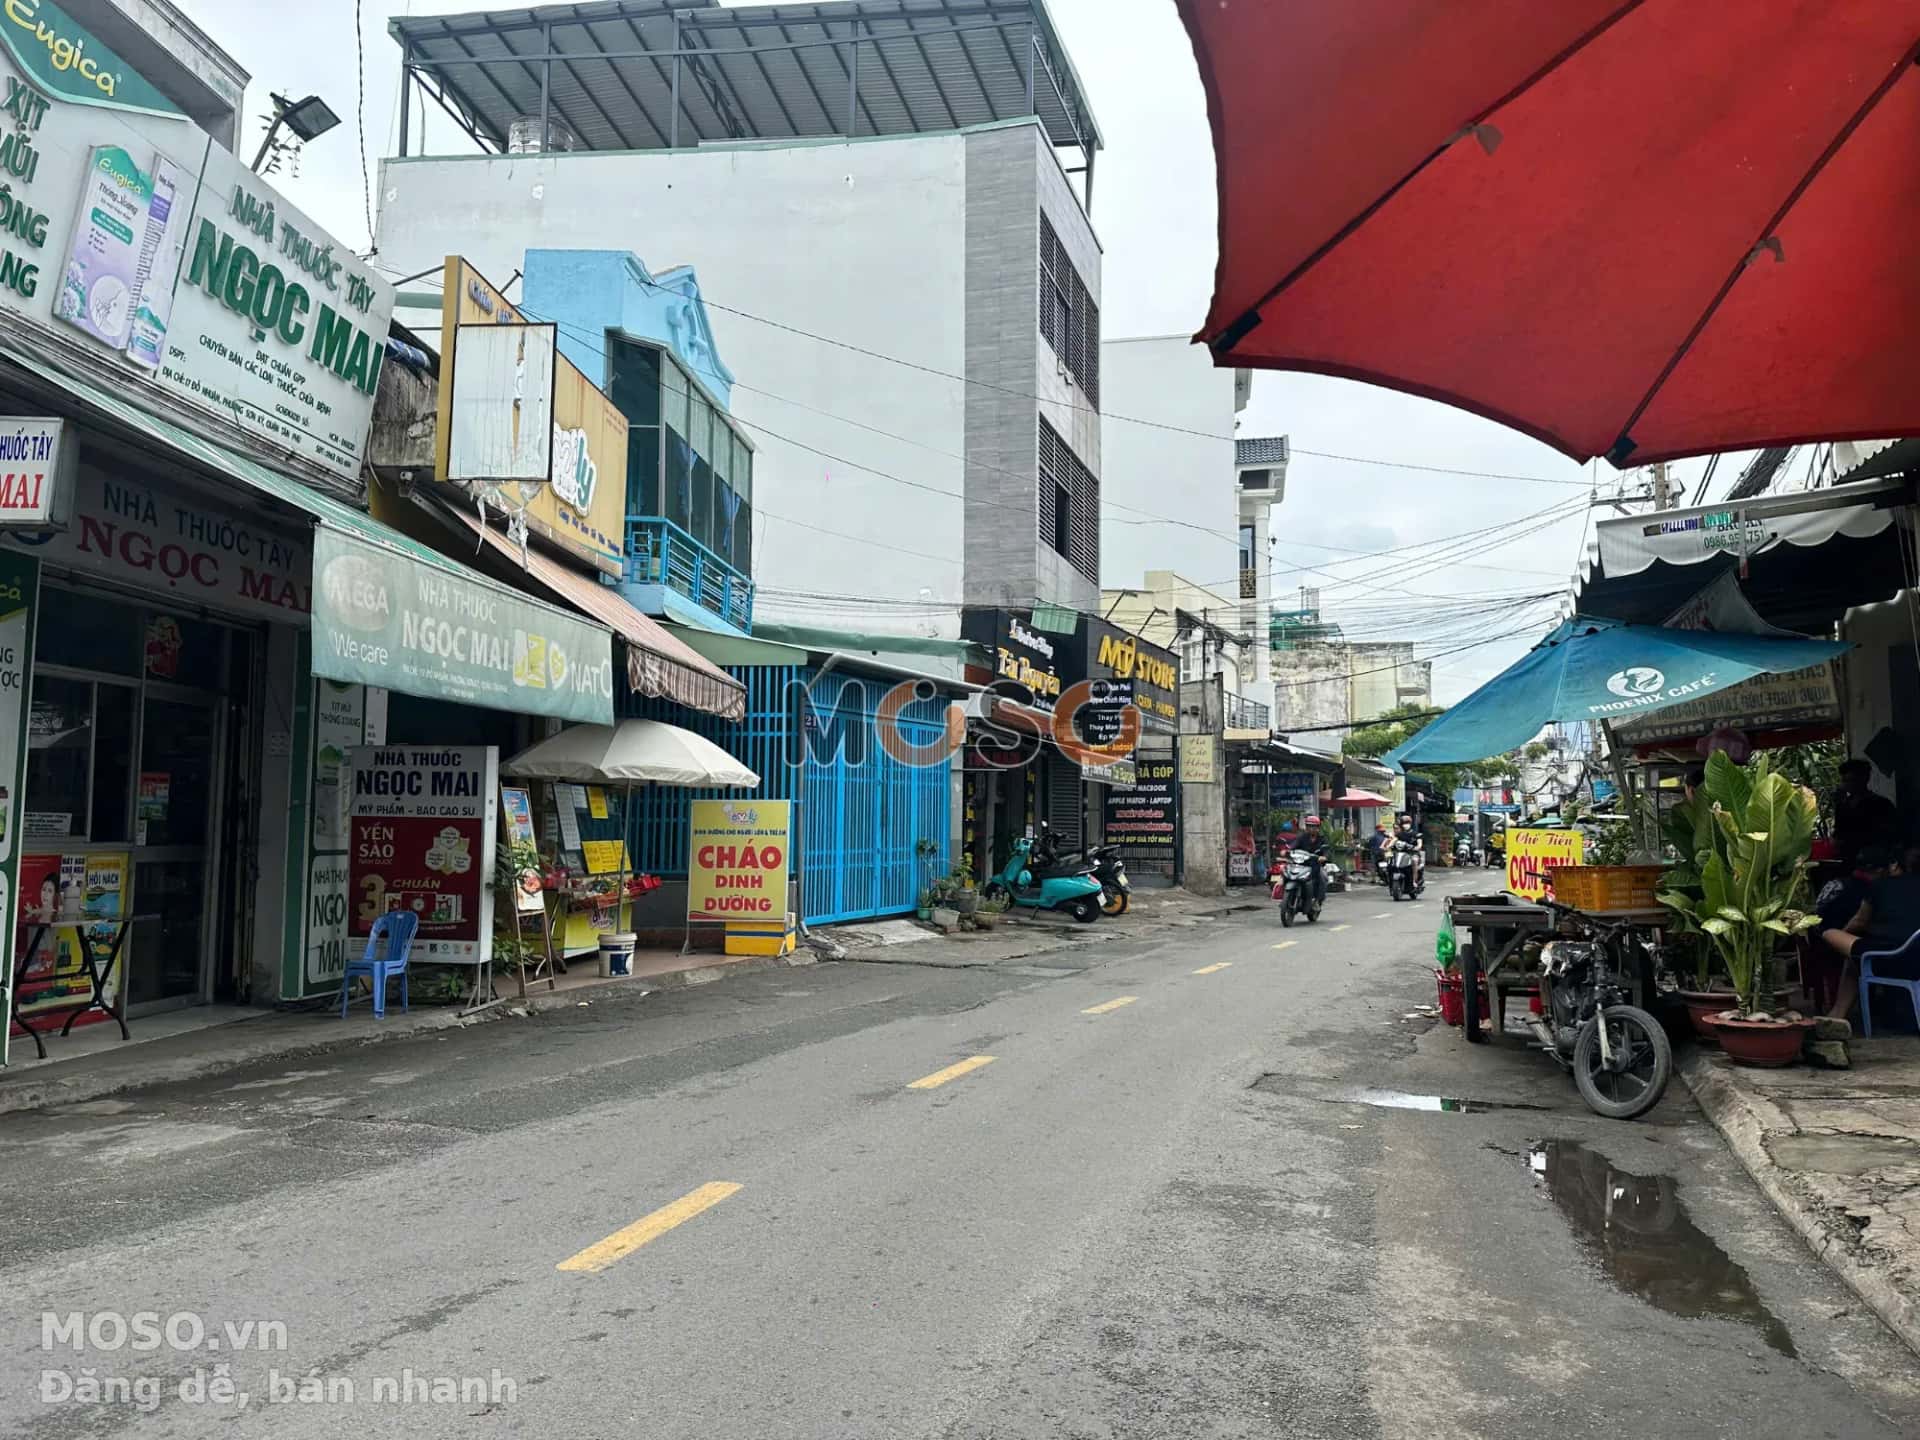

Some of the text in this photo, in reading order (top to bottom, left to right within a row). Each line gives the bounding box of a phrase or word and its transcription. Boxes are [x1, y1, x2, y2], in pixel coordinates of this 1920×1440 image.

[229, 184, 276, 243] NHÀ
[189, 217, 310, 343] NGỌC
[310, 303, 384, 395] MAI
[76, 514, 219, 587] NGỌC
[360, 642, 388, 667] care
[402, 608, 509, 672] NGỌC MAI
[1588, 692, 1664, 714] PHOENIX
[355, 769, 479, 801] NGỌC MAI
[698, 839, 782, 870] CHÁO
[715, 875, 763, 889] DINH
